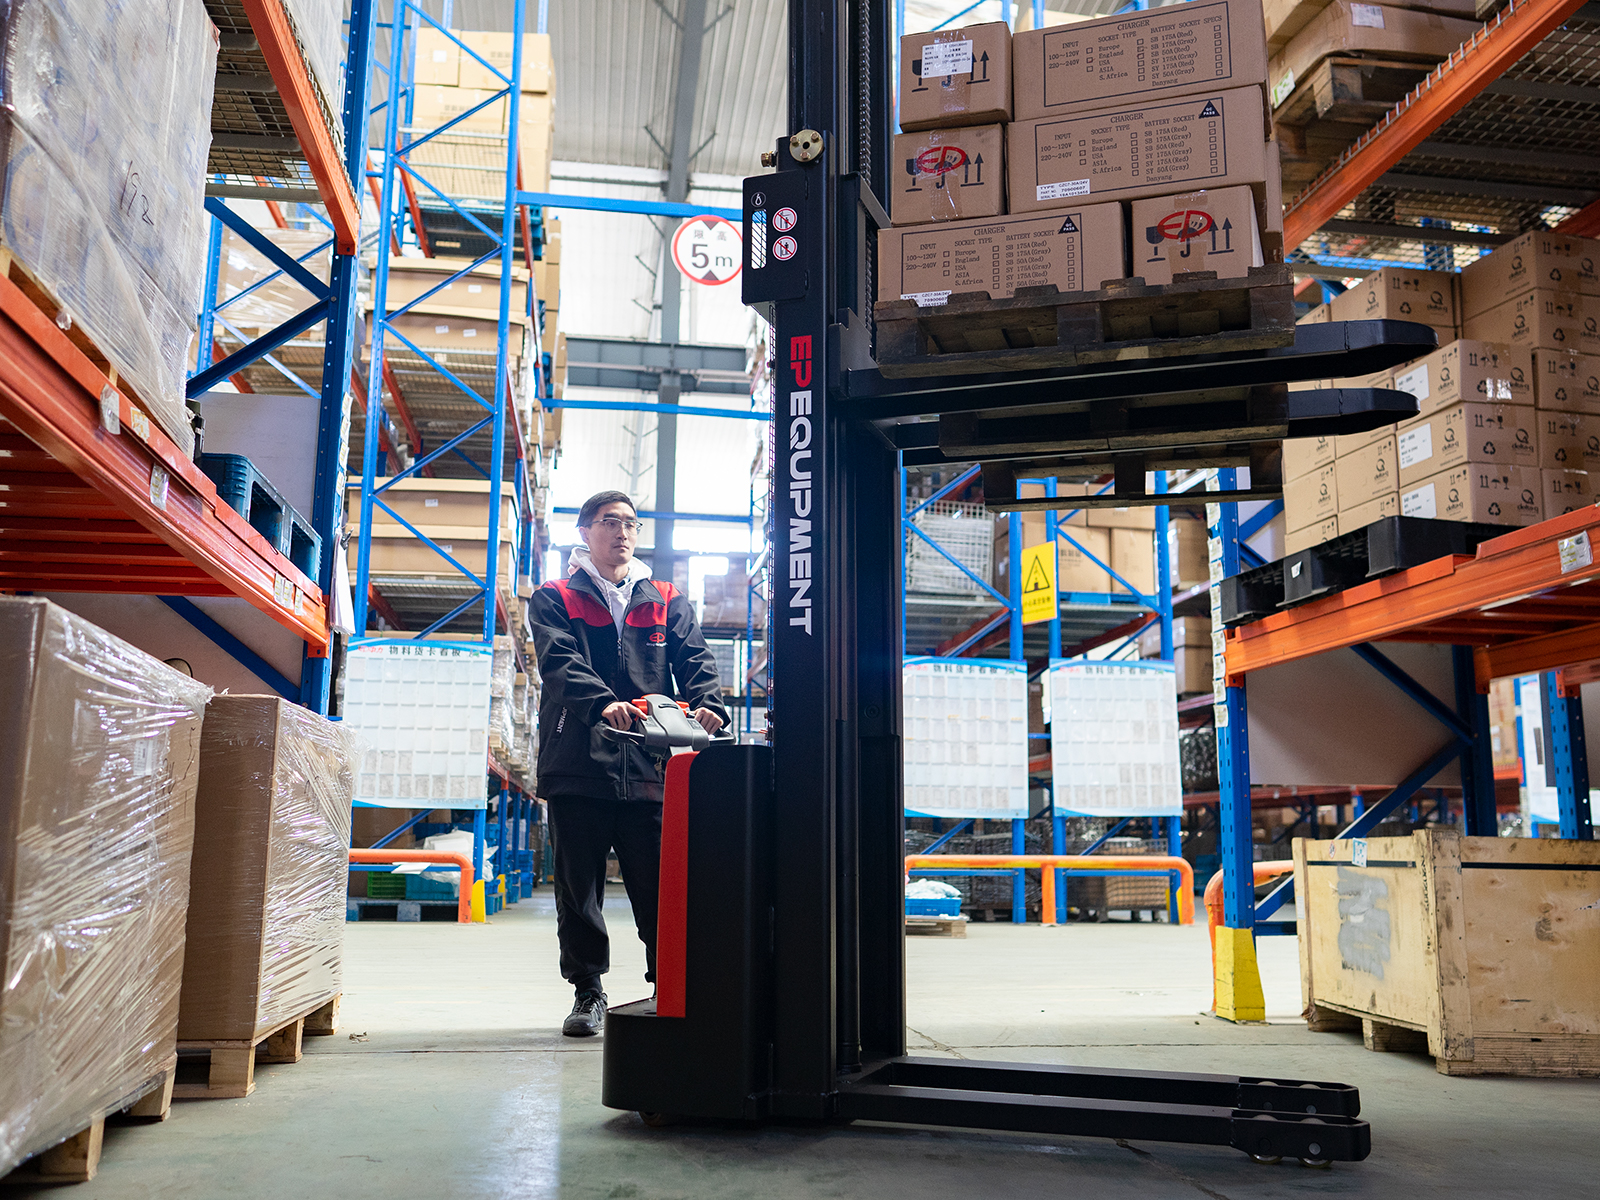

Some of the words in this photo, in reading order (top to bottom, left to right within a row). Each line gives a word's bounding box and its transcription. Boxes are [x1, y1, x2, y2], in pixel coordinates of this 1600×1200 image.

[1117, 20, 1150, 31] CHARGER
[1150, 24, 1176, 33] BATTERY
[1179, 20, 1200, 28] SOCKET
[1204, 16, 1222, 24] SPECS
[1098, 34, 1119, 42] SOCKET
[1099, 50, 1124, 59] England
[1110, 113, 1144, 123] CHARGER
[1145, 118, 1170, 127] BATTERY
[1173, 114, 1195, 123] SOCKET
[1091, 127, 1112, 135] SOCKET
[1092, 143, 1117, 152] England
[974, 226, 1005, 236] CHARGER
[790, 335, 812, 388] EP
[790, 390, 812, 636] EQUIPMENT
[390, 646, 460, 656] 物料货卡看板
